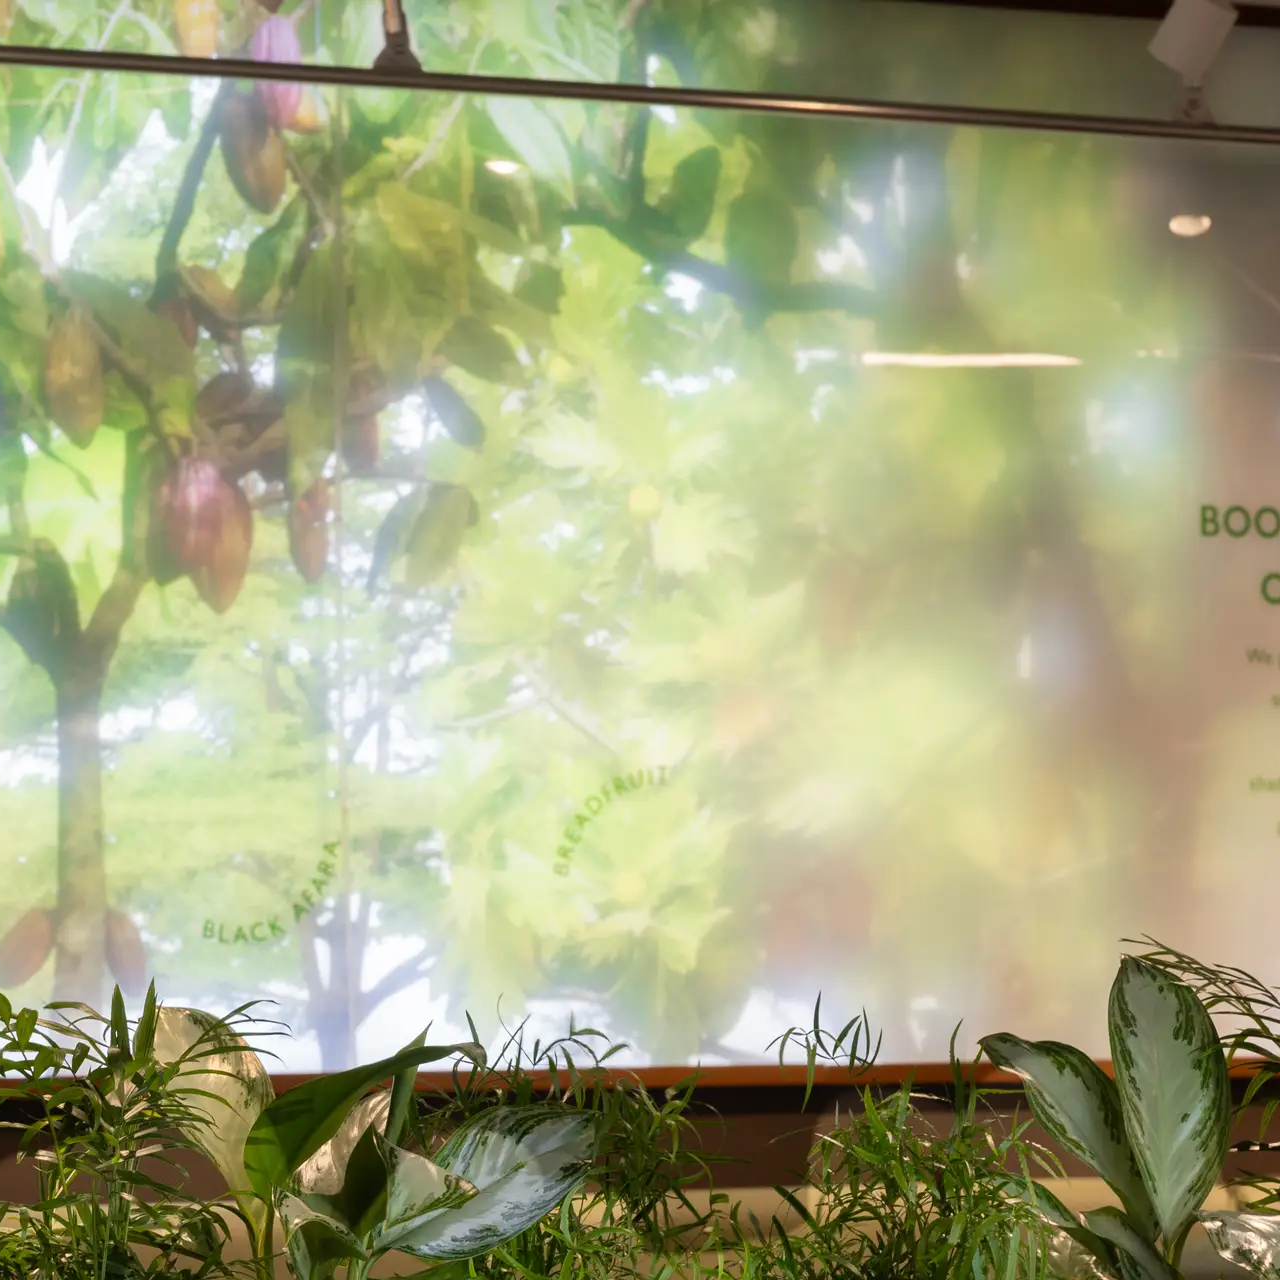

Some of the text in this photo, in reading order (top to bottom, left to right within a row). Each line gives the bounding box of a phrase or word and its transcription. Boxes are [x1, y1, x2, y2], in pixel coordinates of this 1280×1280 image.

[1245, 647, 1273, 665] We
[552, 764, 669, 877] BREADFRUIT
[202, 840, 341, 945] BLACK AFARA
